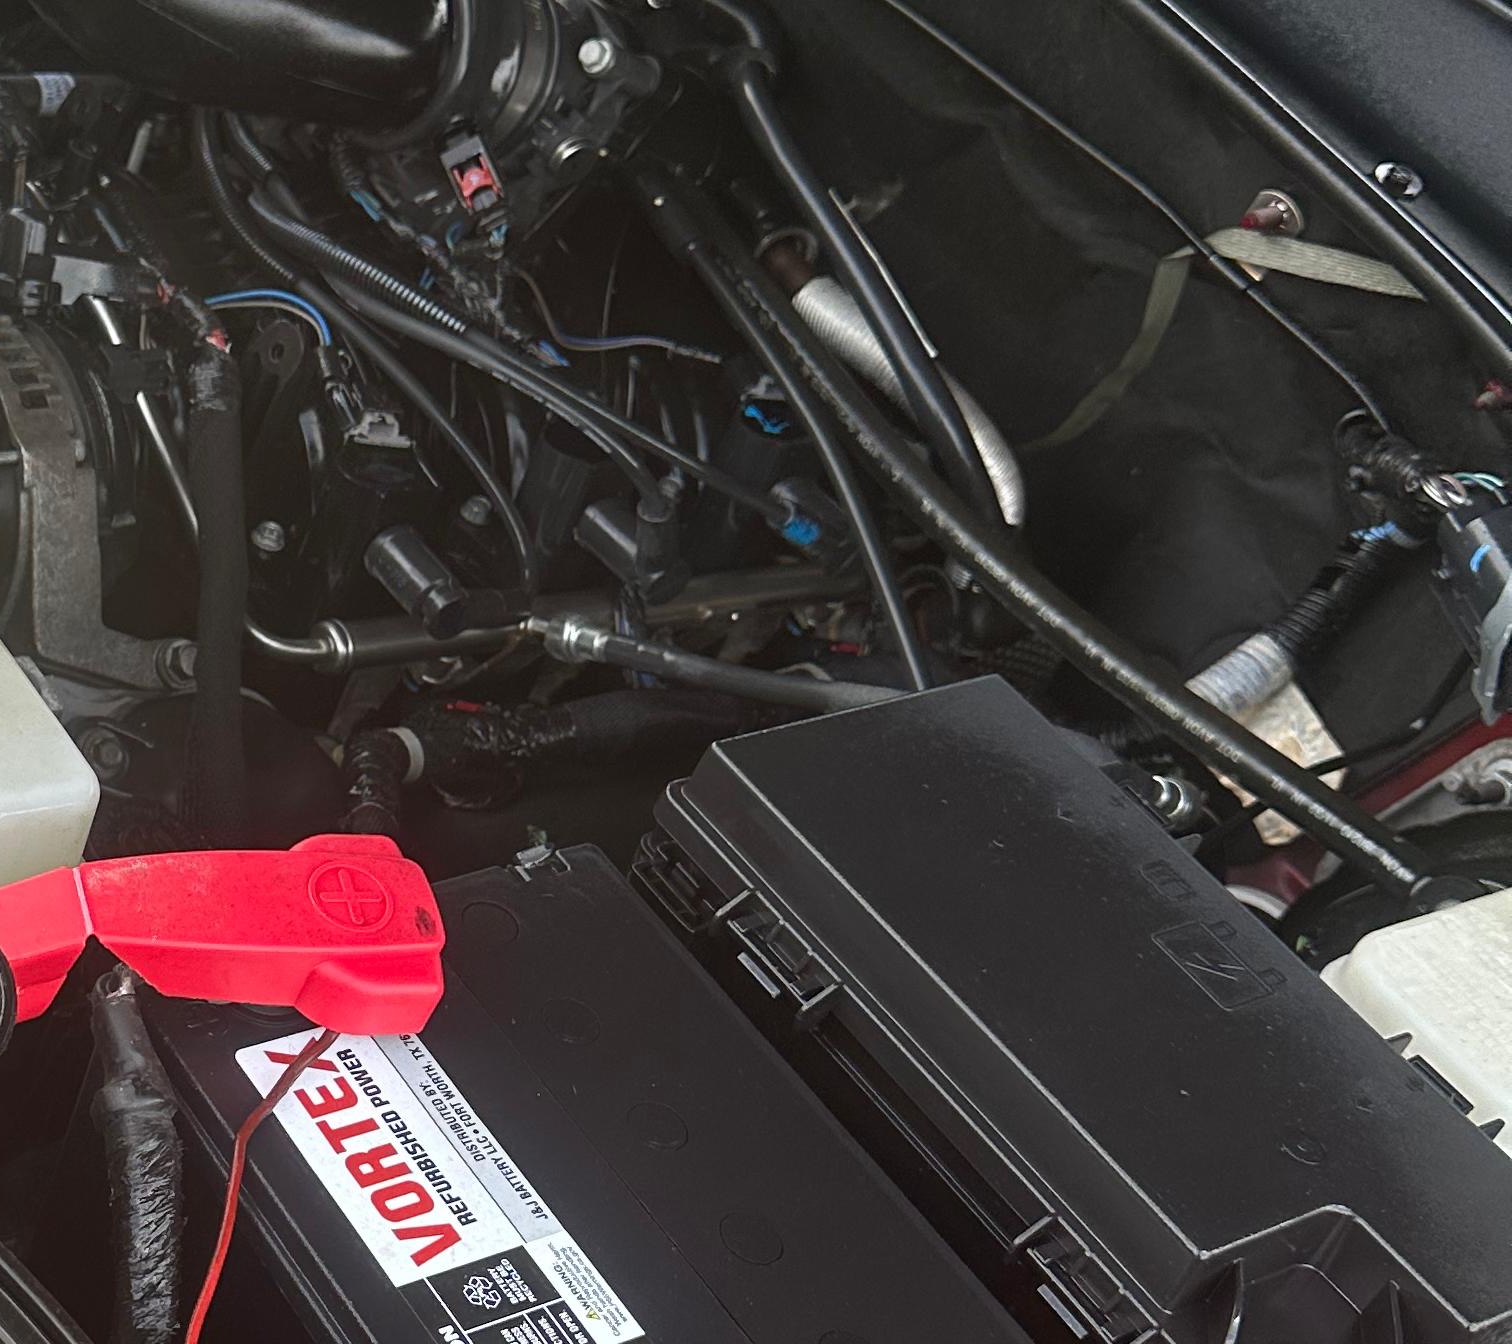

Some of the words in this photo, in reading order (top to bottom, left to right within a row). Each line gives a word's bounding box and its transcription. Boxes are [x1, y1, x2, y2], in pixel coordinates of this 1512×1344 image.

[396, 1031, 418, 1046] 76
[407, 1044, 427, 1059] TX
[334, 1047, 391, 1108] POWER
[417, 1059, 457, 1100] WORTH,
[447, 1099, 478, 1128] FORT
[429, 1096, 487, 1162] DISTRIBUTED
[263, 1036, 462, 1266] VORTEX
[475, 1134, 499, 1155] LLC
[379, 1109, 478, 1226] REFURBISHED
[490, 1155, 534, 1200] BATTERY
[525, 1199, 550, 1221] J&J
[486, 1265, 519, 1304] BATTERY
[494, 1263, 509, 1277] BE
[498, 1256, 538, 1302] RECYCLED
[504, 1276, 527, 1301] MUST
[498, 1327, 516, 1342] CAN
[572, 1331, 589, 1344] OR
